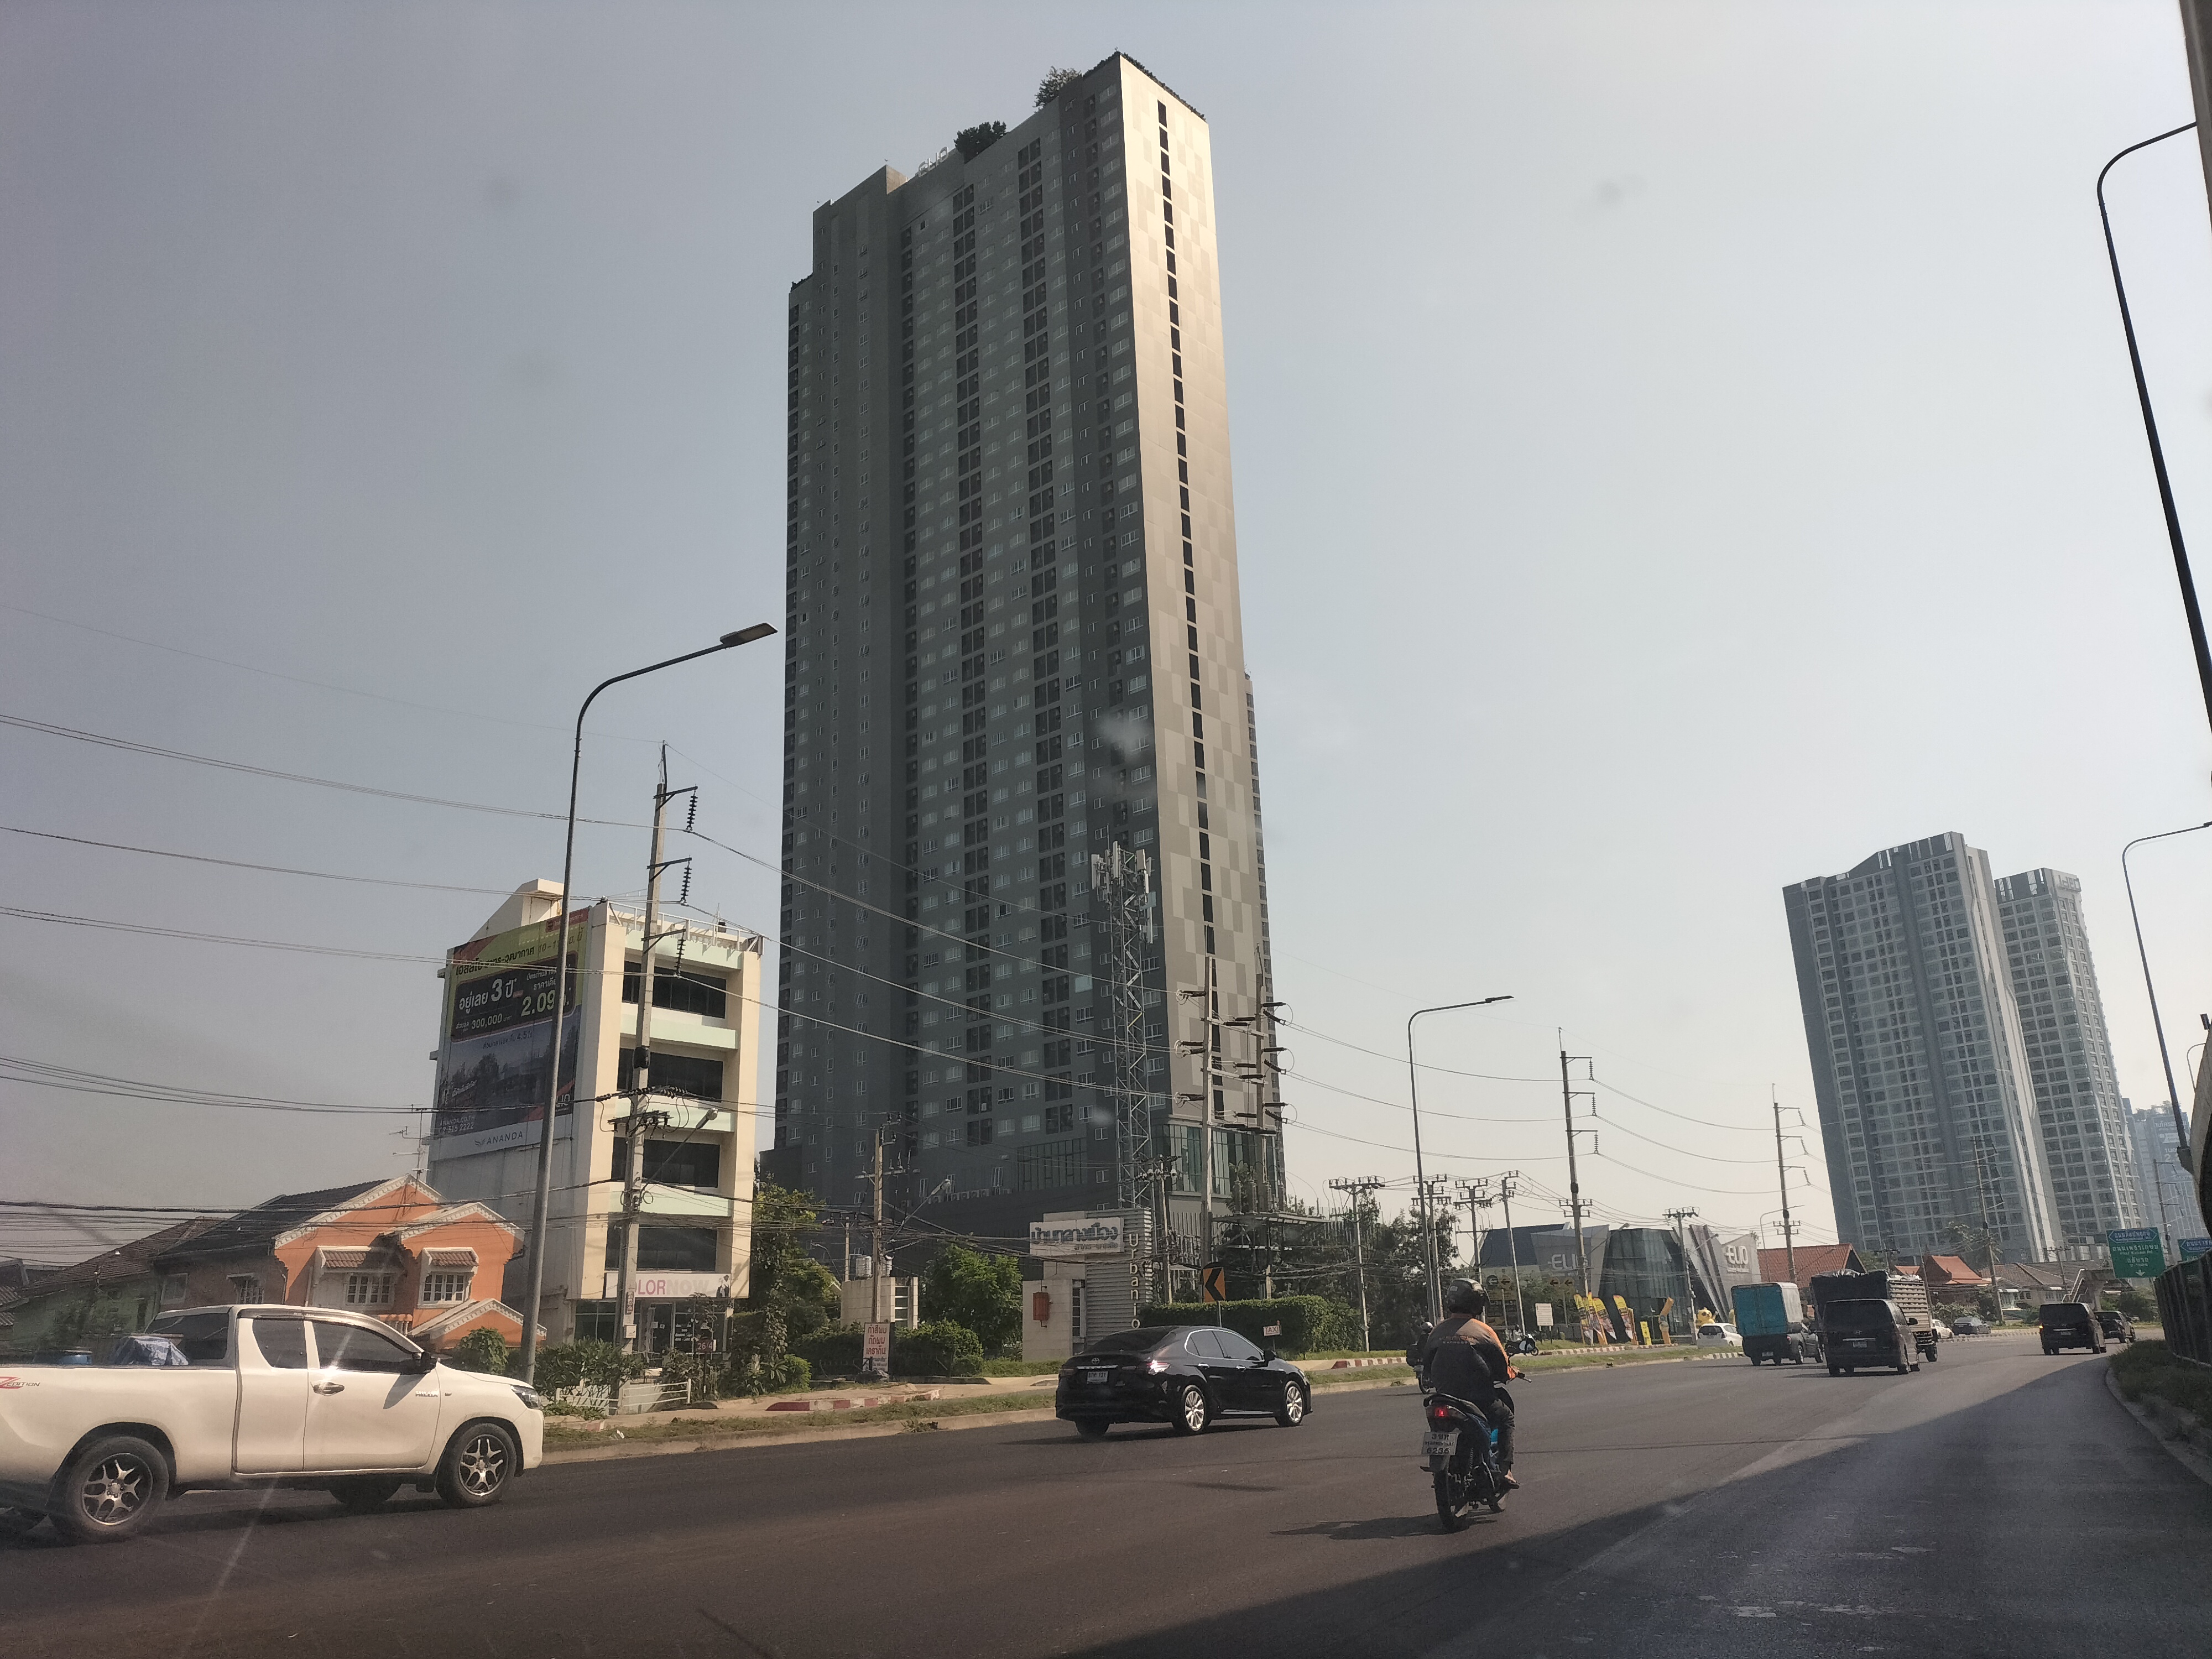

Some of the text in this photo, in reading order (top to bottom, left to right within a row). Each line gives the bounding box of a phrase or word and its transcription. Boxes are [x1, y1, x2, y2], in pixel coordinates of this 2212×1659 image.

[459, 991, 488, 1014] อยู่เลย
[491, 978, 503, 1001] 3
[471, 1013, 503, 1029] 300,000
[486, 1131, 523, 1145] ANANDA
[1725, 1245, 1749, 1265] ELIO
[1129, 1233, 1141, 1329] Urbanio
[697, 1340, 713, 1350] 26/4
